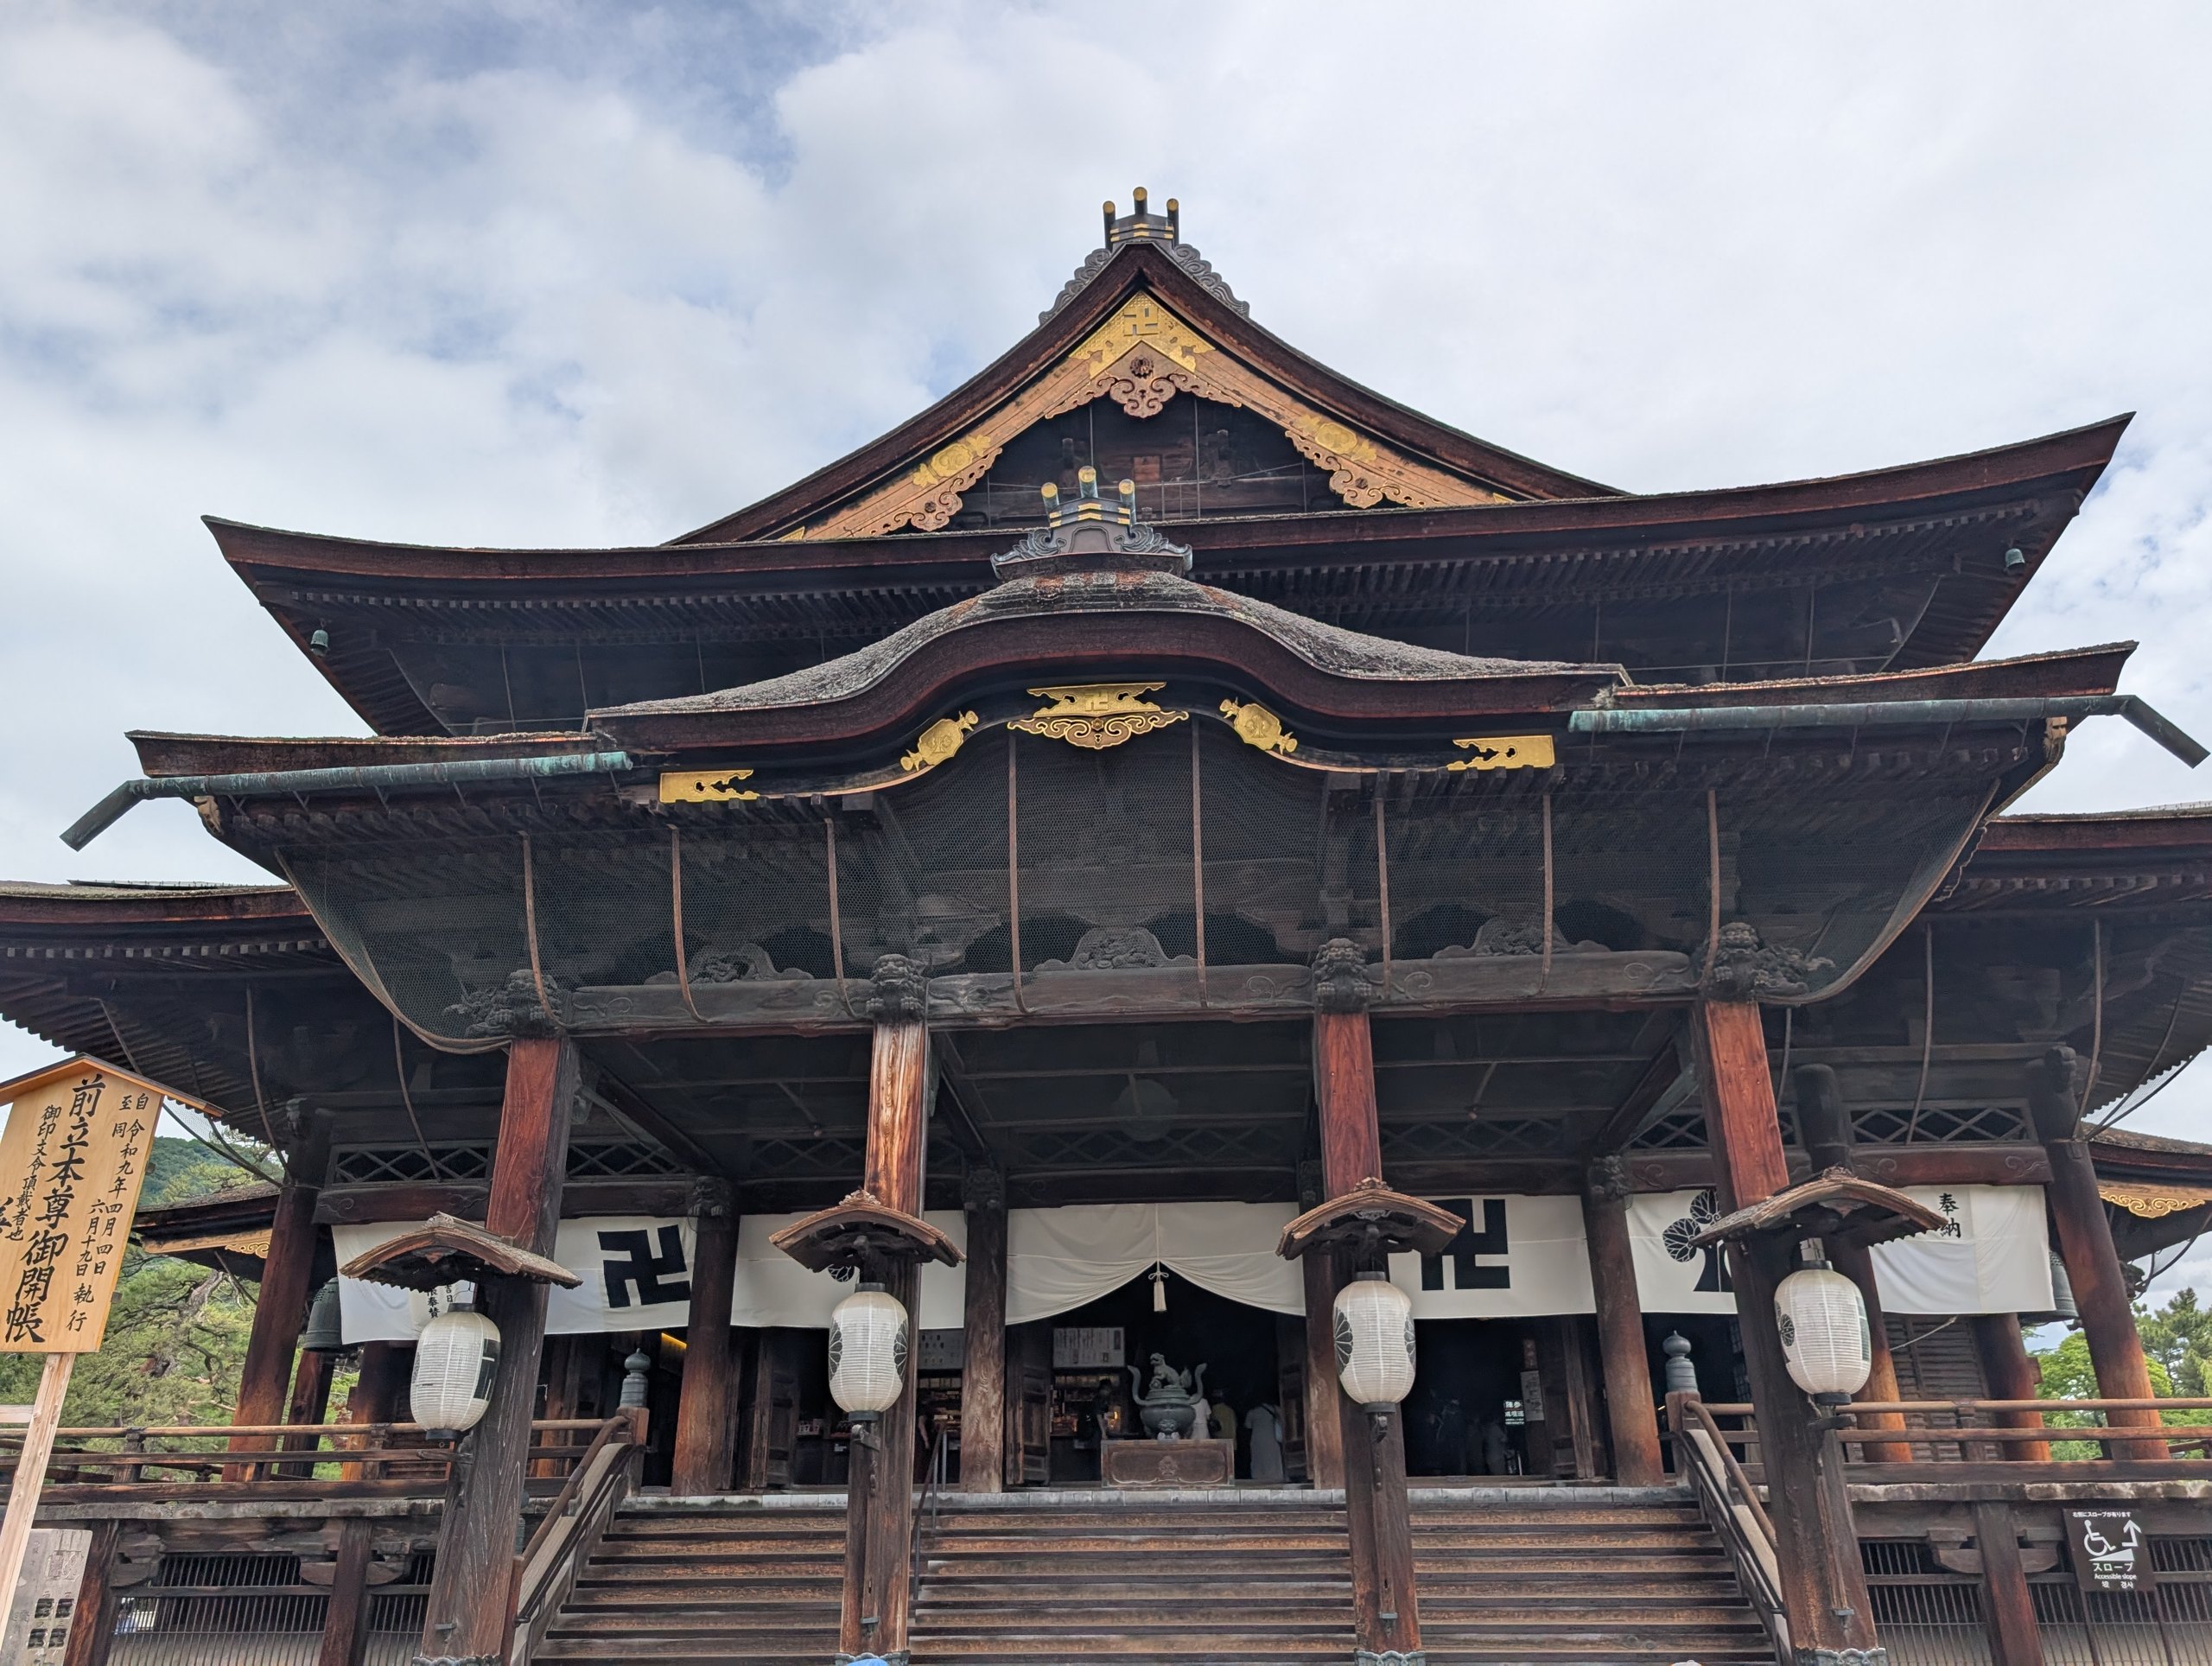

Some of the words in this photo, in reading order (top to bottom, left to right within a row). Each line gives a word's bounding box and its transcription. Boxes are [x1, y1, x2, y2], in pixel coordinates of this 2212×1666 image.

[5, 1073, 106, 1344] 前立本尊御開帳
[1938, 1192, 1961, 1238] 奉納
[2092, 1562, 2133, 1572] スロープ
